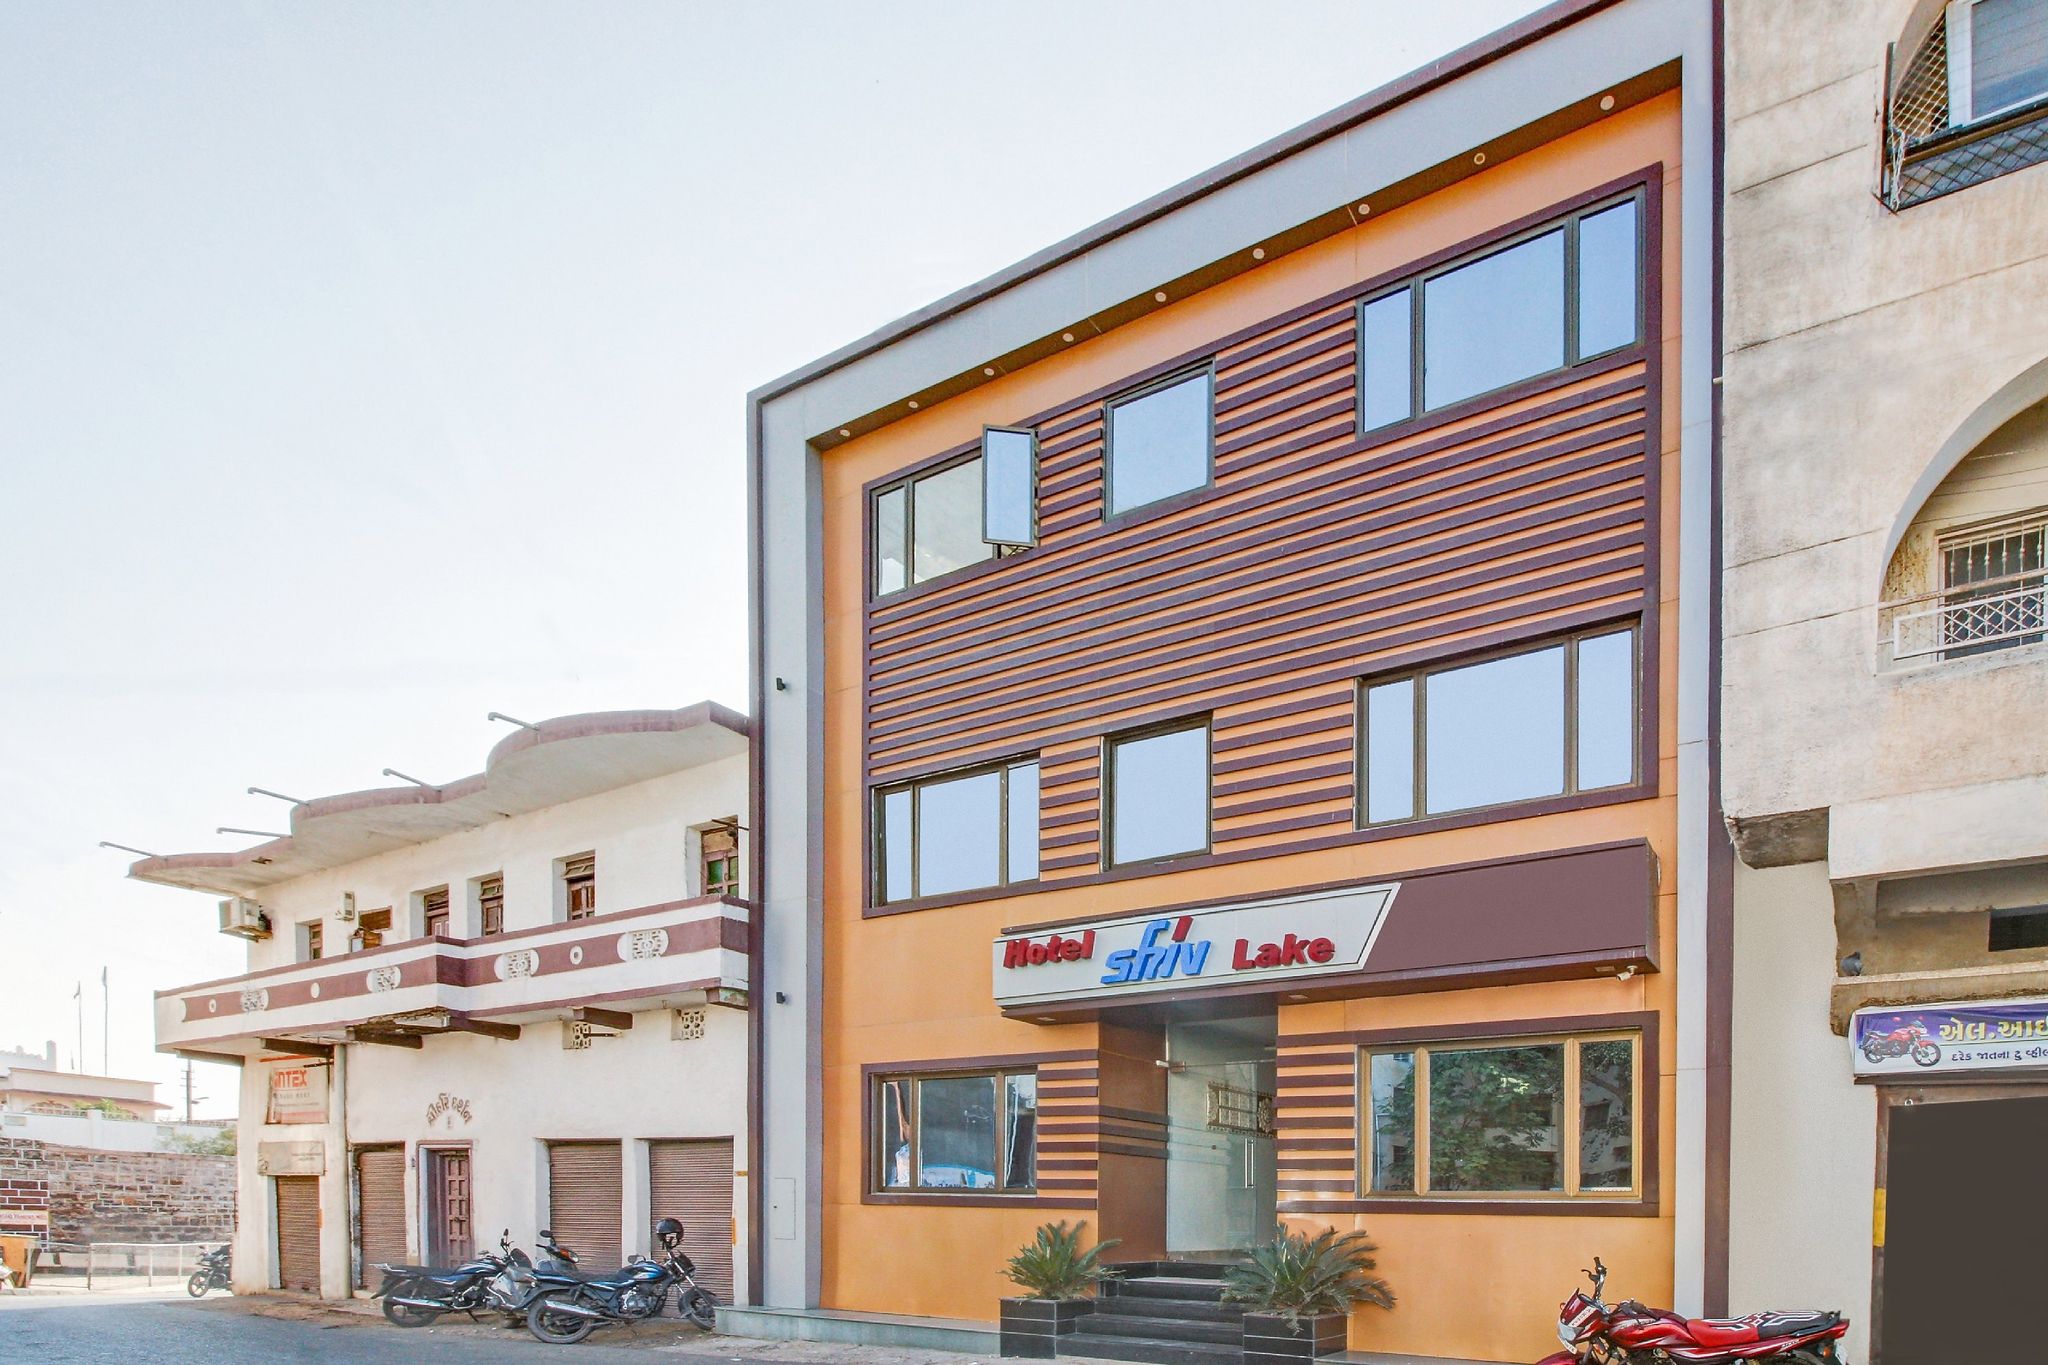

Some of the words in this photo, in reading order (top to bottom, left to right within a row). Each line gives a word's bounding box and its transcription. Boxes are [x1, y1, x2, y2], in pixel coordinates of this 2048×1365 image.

[1003, 929, 1096, 970] Hotel
[1232, 933, 1336, 971] Lake
[1952, 1050, 1972, 1061] દરેક
[1977, 1051, 2010, 1060] જાતના
